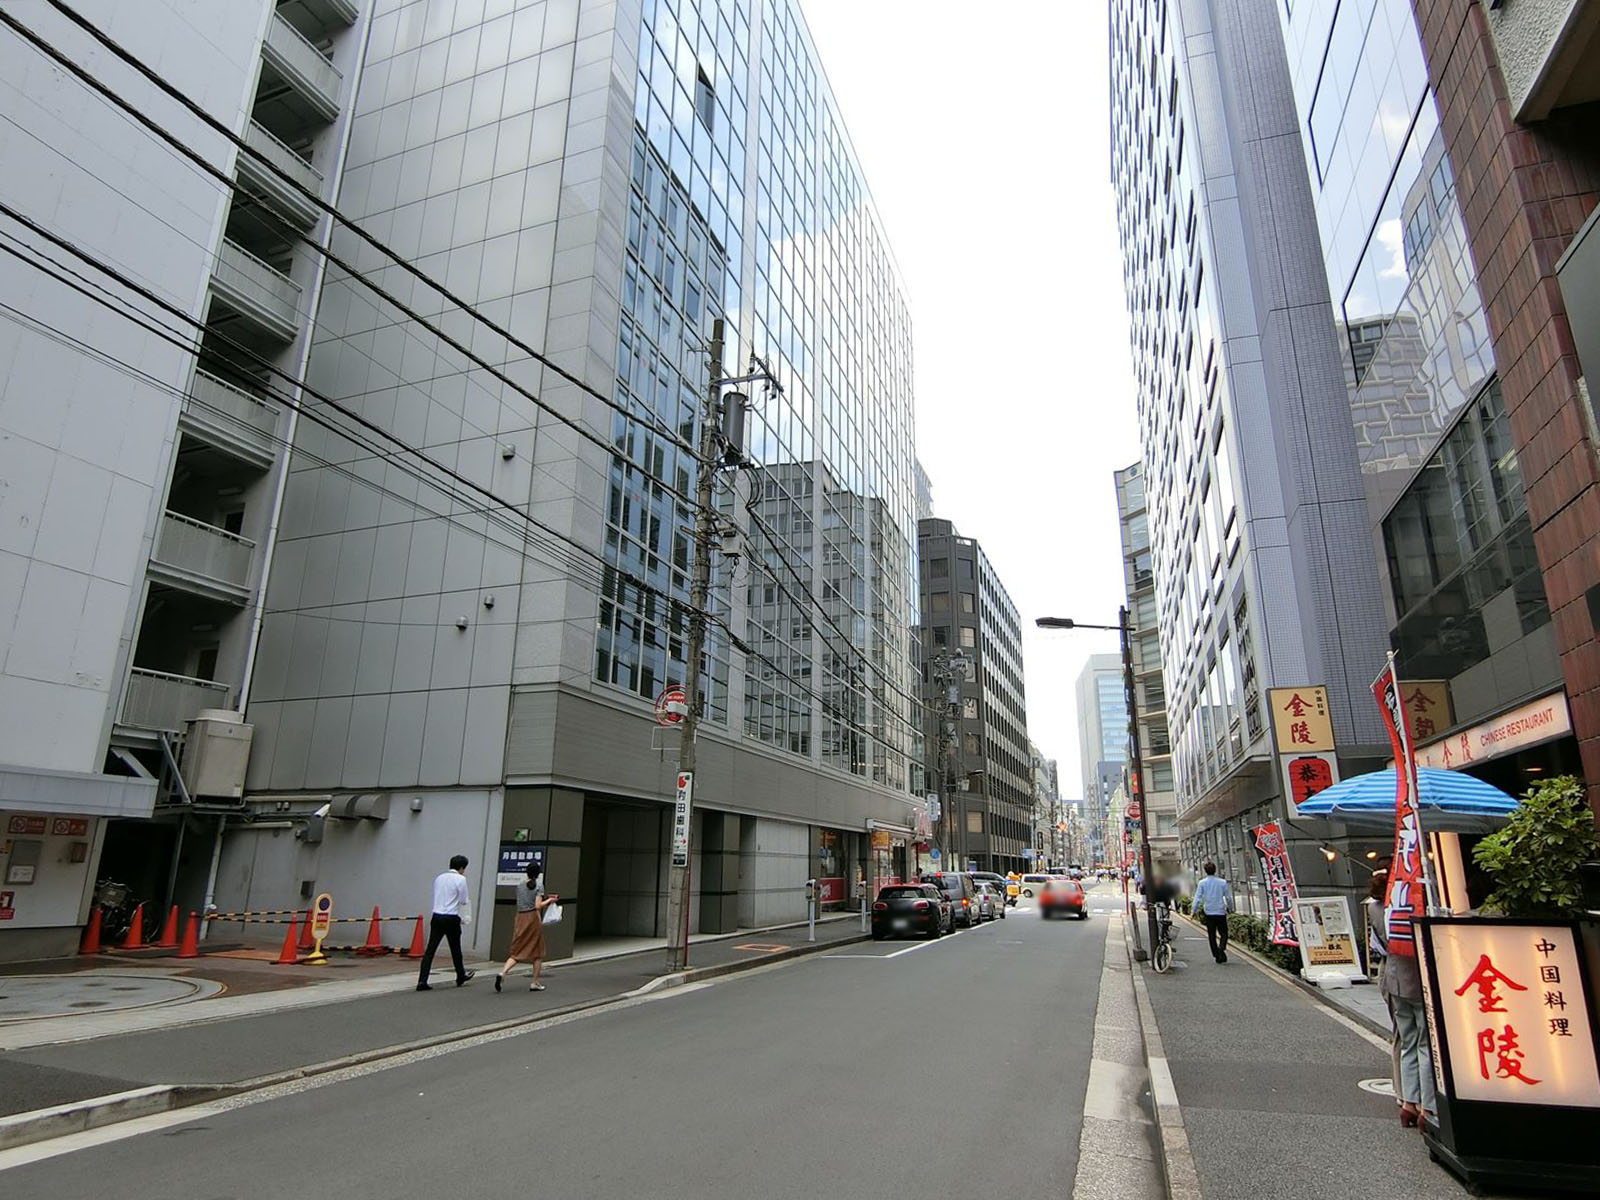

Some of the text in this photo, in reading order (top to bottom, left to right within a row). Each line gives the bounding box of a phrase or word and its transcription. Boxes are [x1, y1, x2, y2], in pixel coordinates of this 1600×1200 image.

[1283, 692, 1317, 745] 金陵
[1480, 726, 1507, 748] CHINESE
[1506, 707, 1554, 738] RESTAURANT
[1454, 953, 1543, 1085] 金陵
[1534, 938, 1573, 1037] 中国料理
